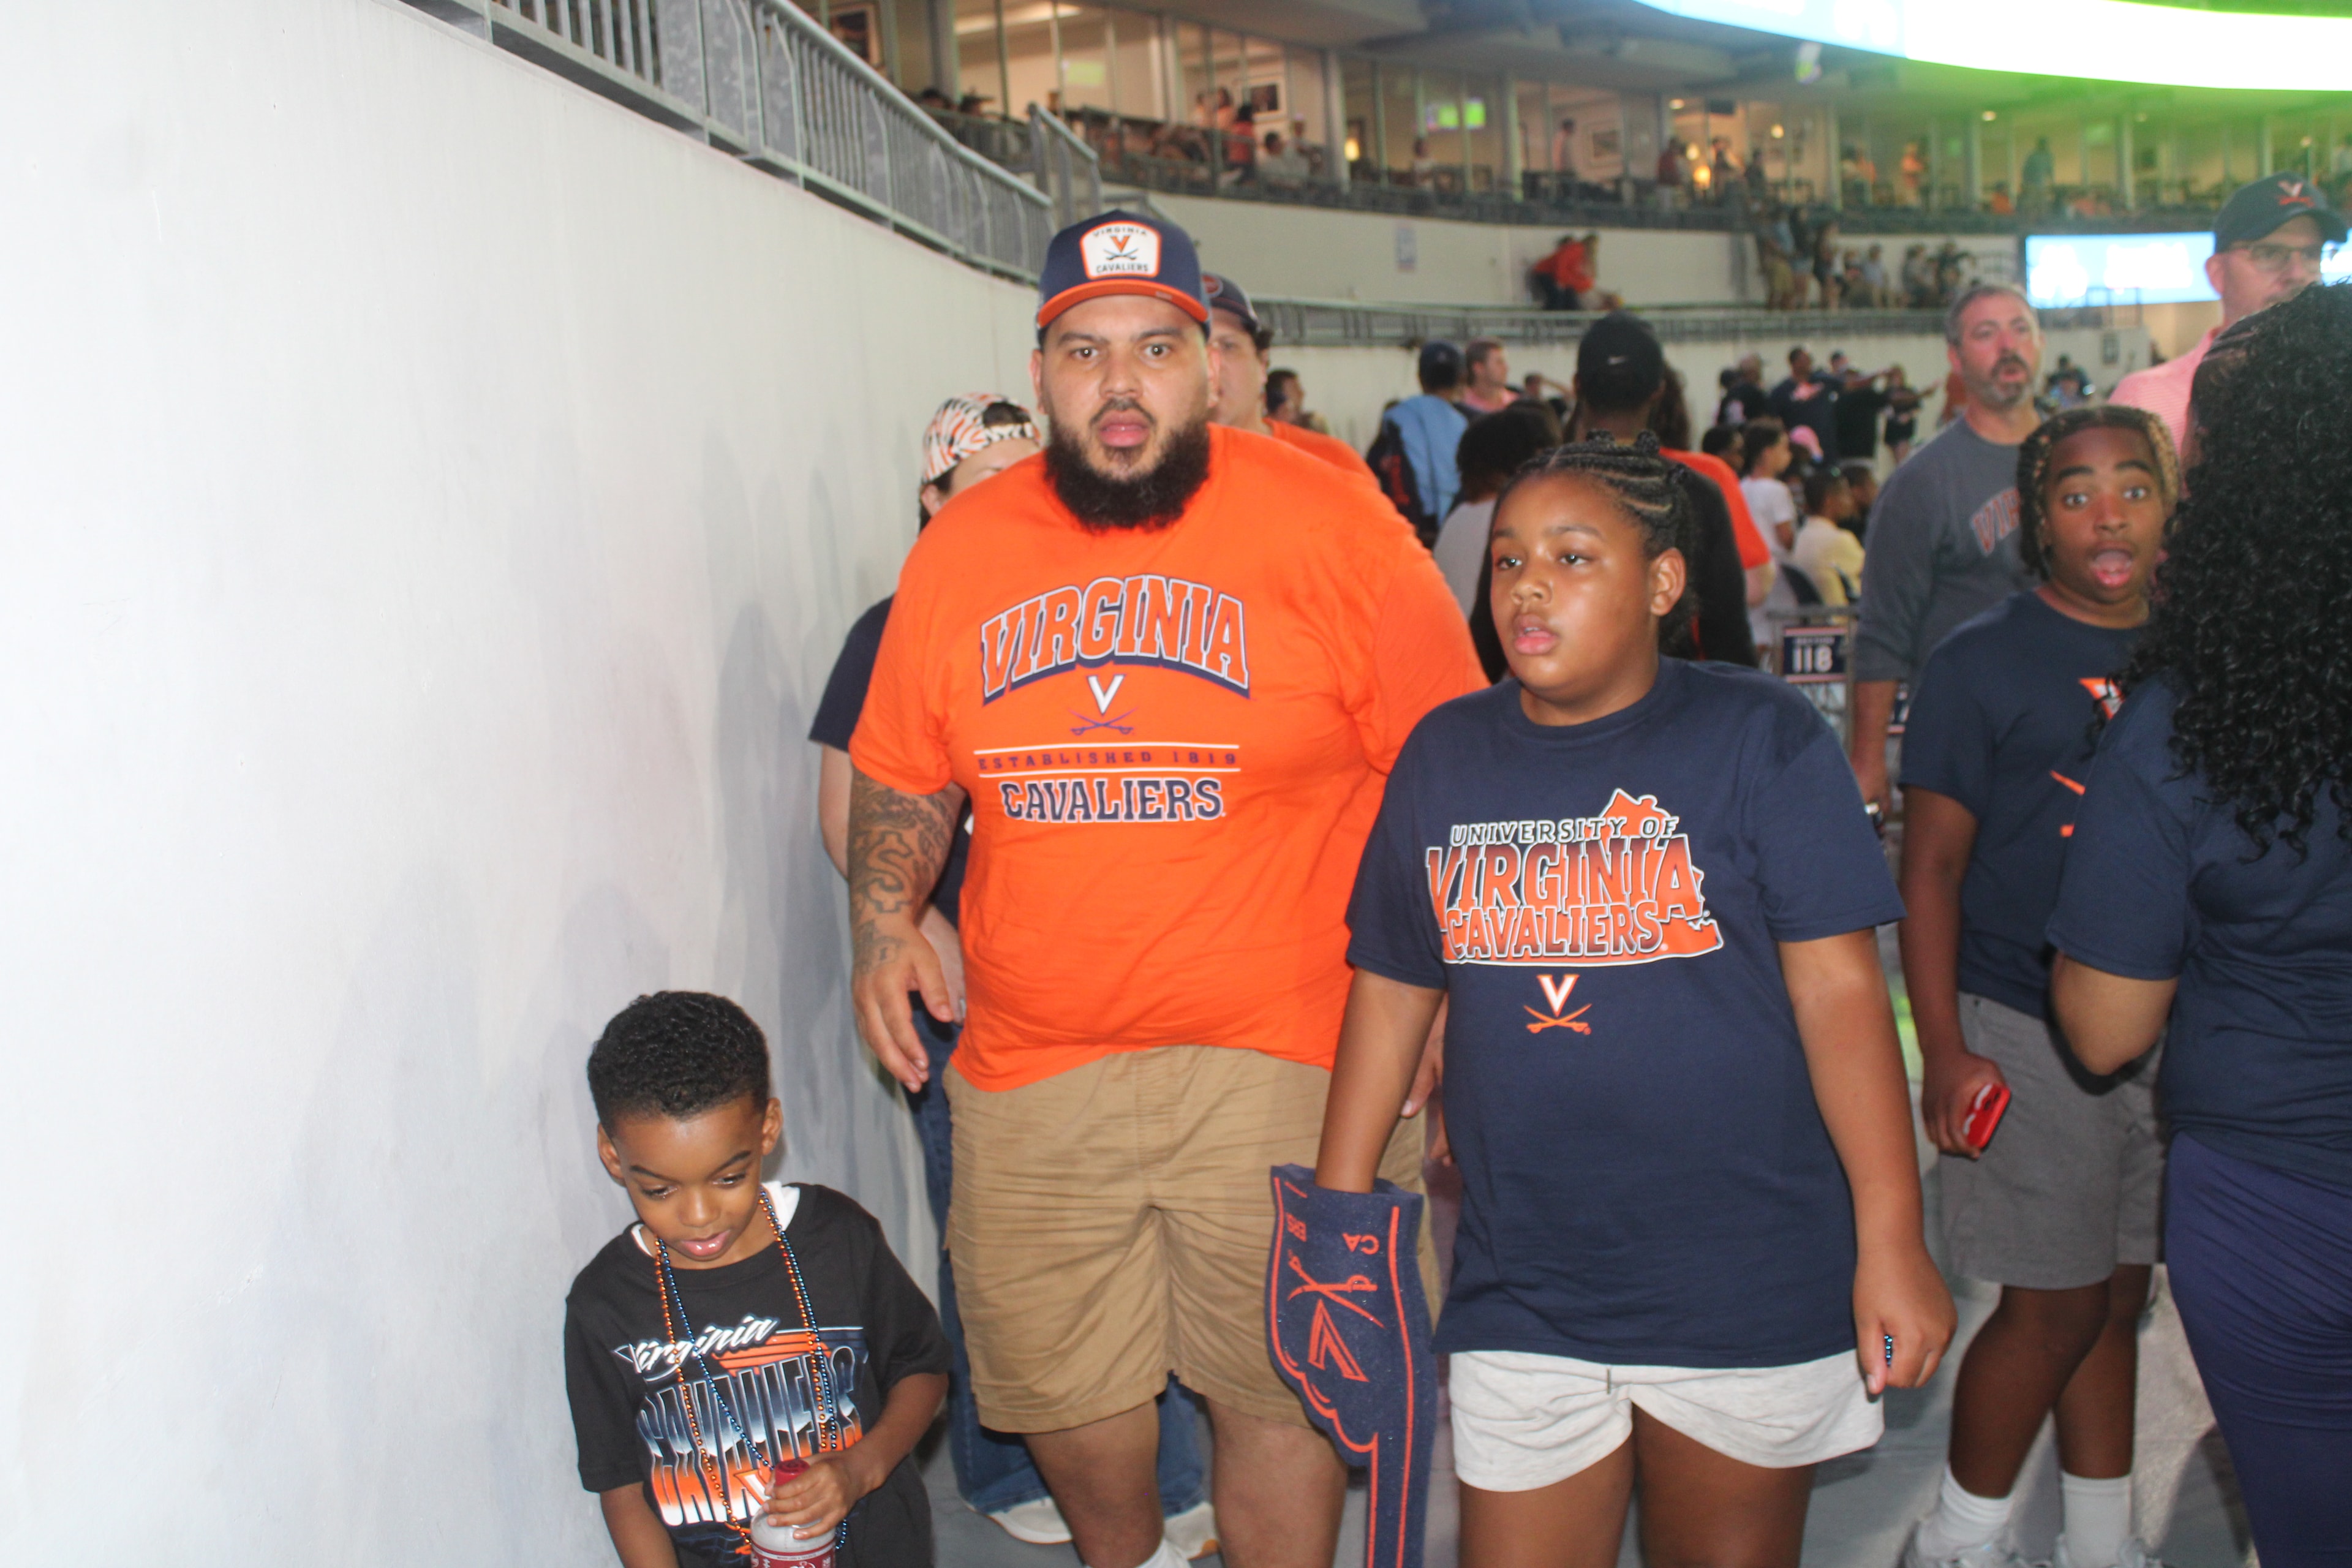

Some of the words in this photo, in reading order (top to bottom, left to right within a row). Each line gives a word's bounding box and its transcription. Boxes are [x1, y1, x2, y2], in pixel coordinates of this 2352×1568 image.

[1093, 225, 1147, 238] VIRGINIA
[1096, 263, 1149, 273] CAVALIERS
[980, 573, 1250, 707] VIRGINIA
[1792, 646, 1833, 673] 118
[979, 752, 1153, 771] ESTABLISHED
[1172, 750, 1237, 765] 1819
[1000, 778, 1223, 823] CAVALIERS
[1450, 816, 1627, 846] UNIVERSITY
[1641, 816, 1679, 839] OF
[1425, 834, 1702, 932] VIRGINIA
[1446, 900, 1664, 959] CAVALIERS
[613, 1315, 780, 1382] Virginia
